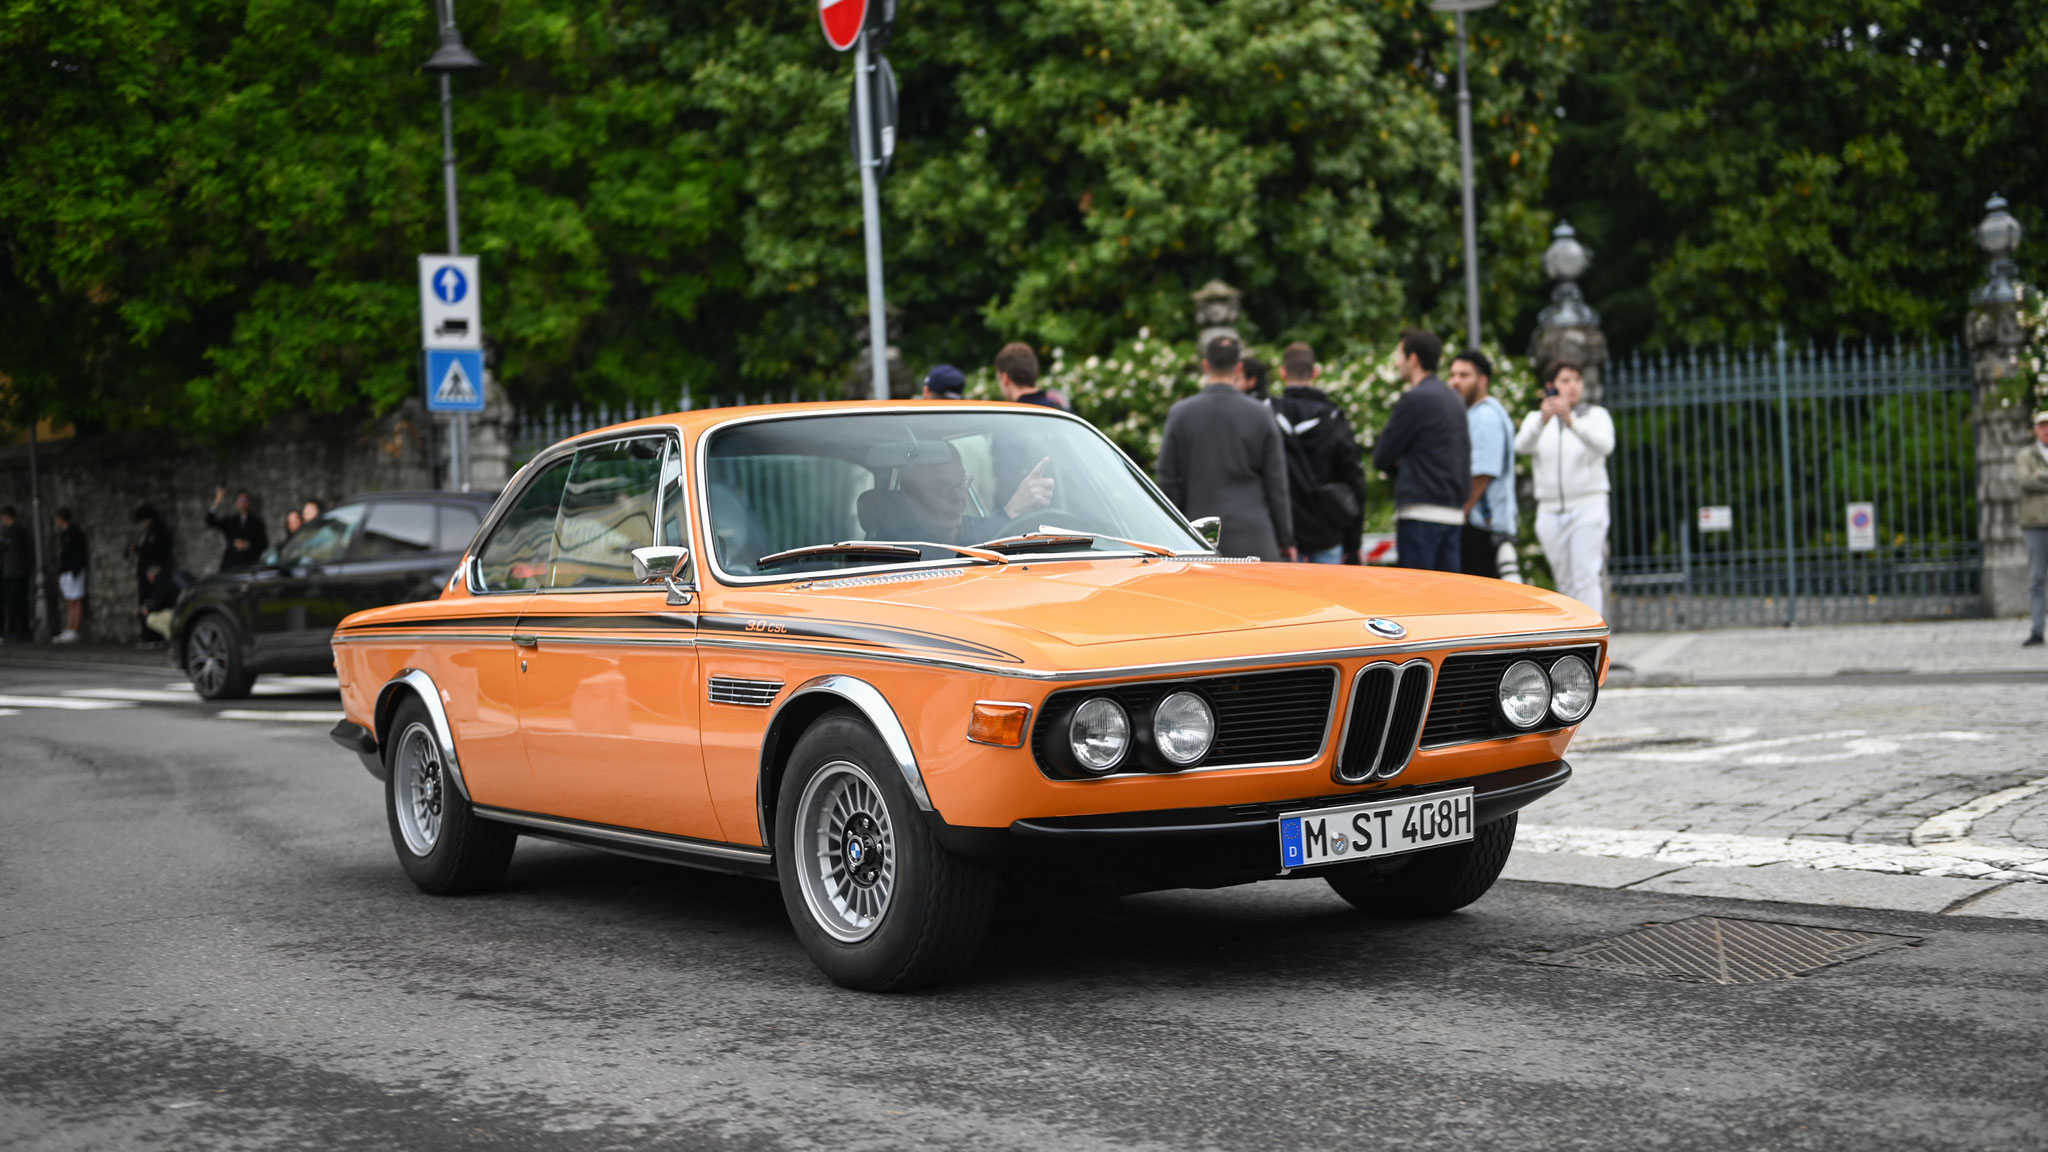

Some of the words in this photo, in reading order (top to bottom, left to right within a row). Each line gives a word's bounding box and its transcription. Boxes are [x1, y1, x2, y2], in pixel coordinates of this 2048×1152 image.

[1304, 818, 1328, 858] M
[1352, 809, 1393, 852] ST
[1402, 796, 1472, 843] 408H
[1289, 846, 1298, 858] D
